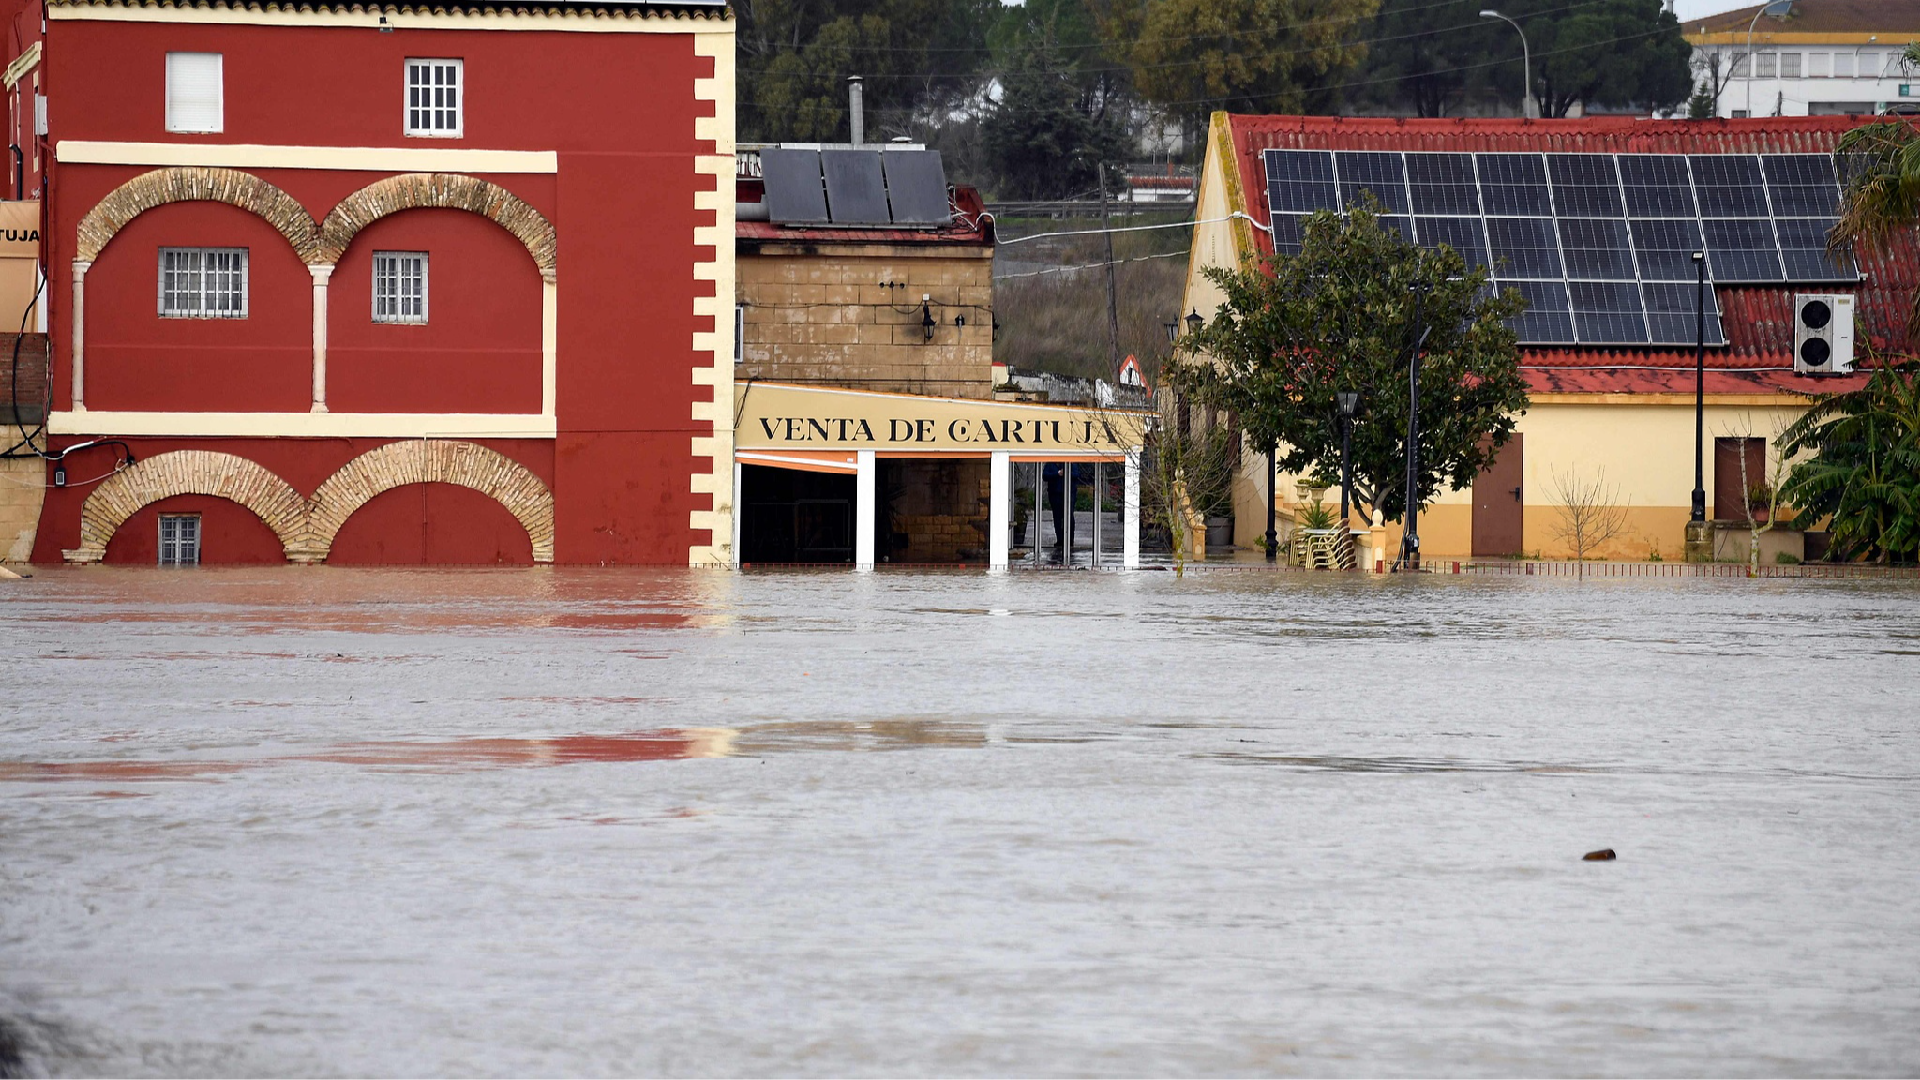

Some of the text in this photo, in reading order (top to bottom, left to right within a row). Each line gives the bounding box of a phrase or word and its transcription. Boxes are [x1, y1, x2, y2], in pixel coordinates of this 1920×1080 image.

[759, 417, 1118, 444] VENTA DE CARTUJA
